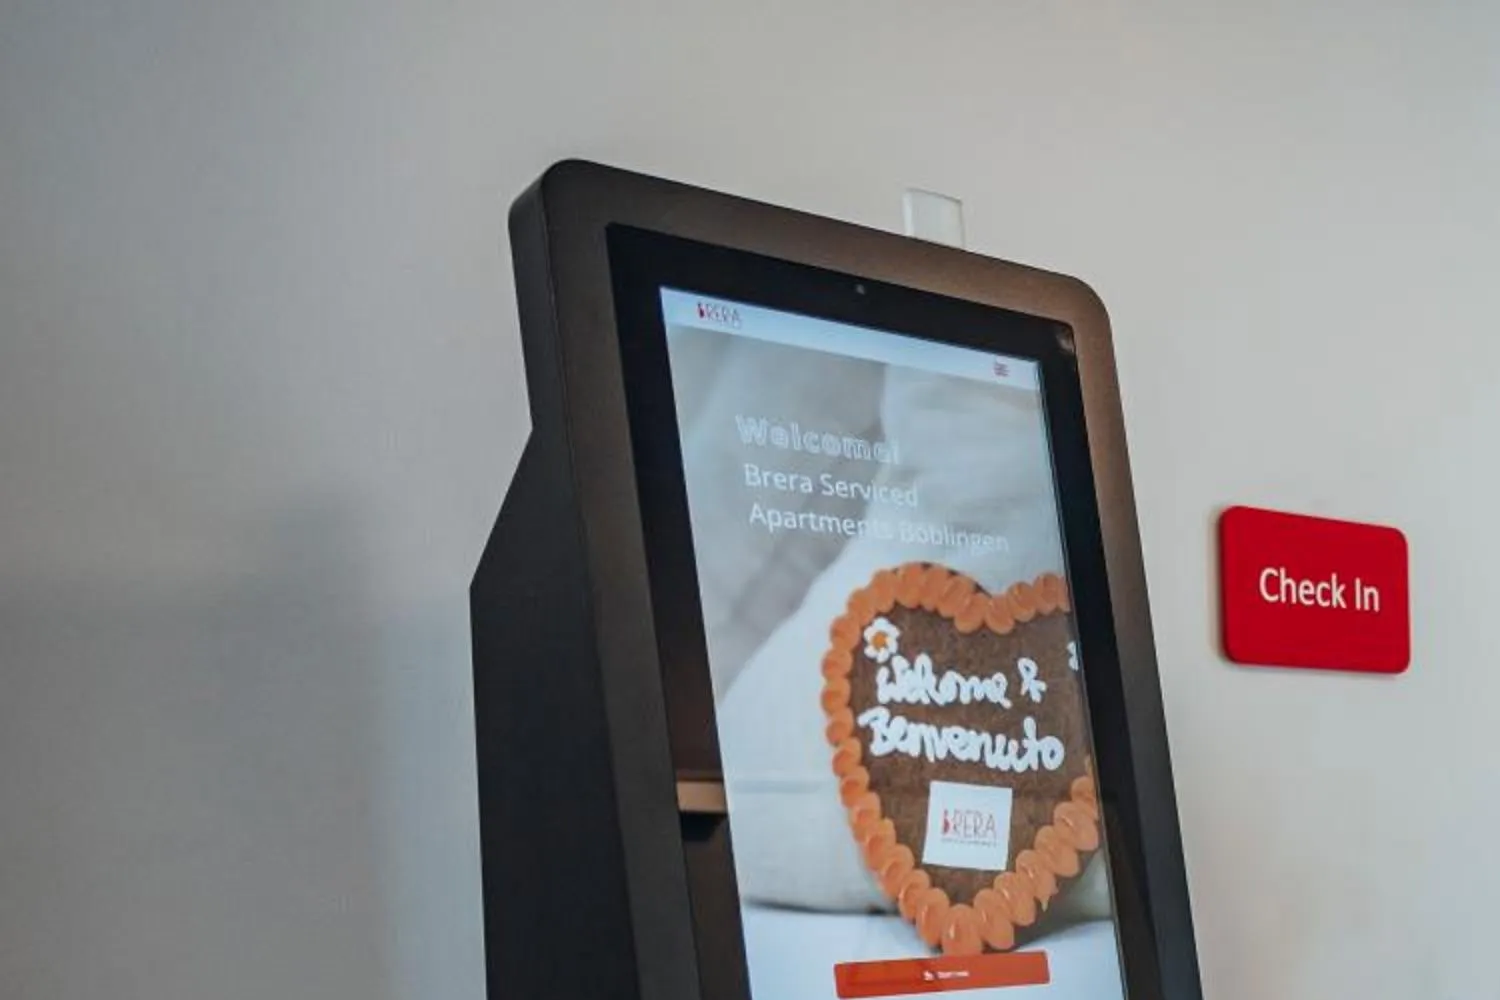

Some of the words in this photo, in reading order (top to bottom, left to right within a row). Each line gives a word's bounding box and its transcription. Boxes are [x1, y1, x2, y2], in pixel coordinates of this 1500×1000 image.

[744, 463, 813, 494] Brera
[820, 473, 918, 508] Serviced
[1259, 567, 1347, 609] Check
[1355, 576, 1380, 612] In
[857, 706, 1064, 773] Benvenuto
